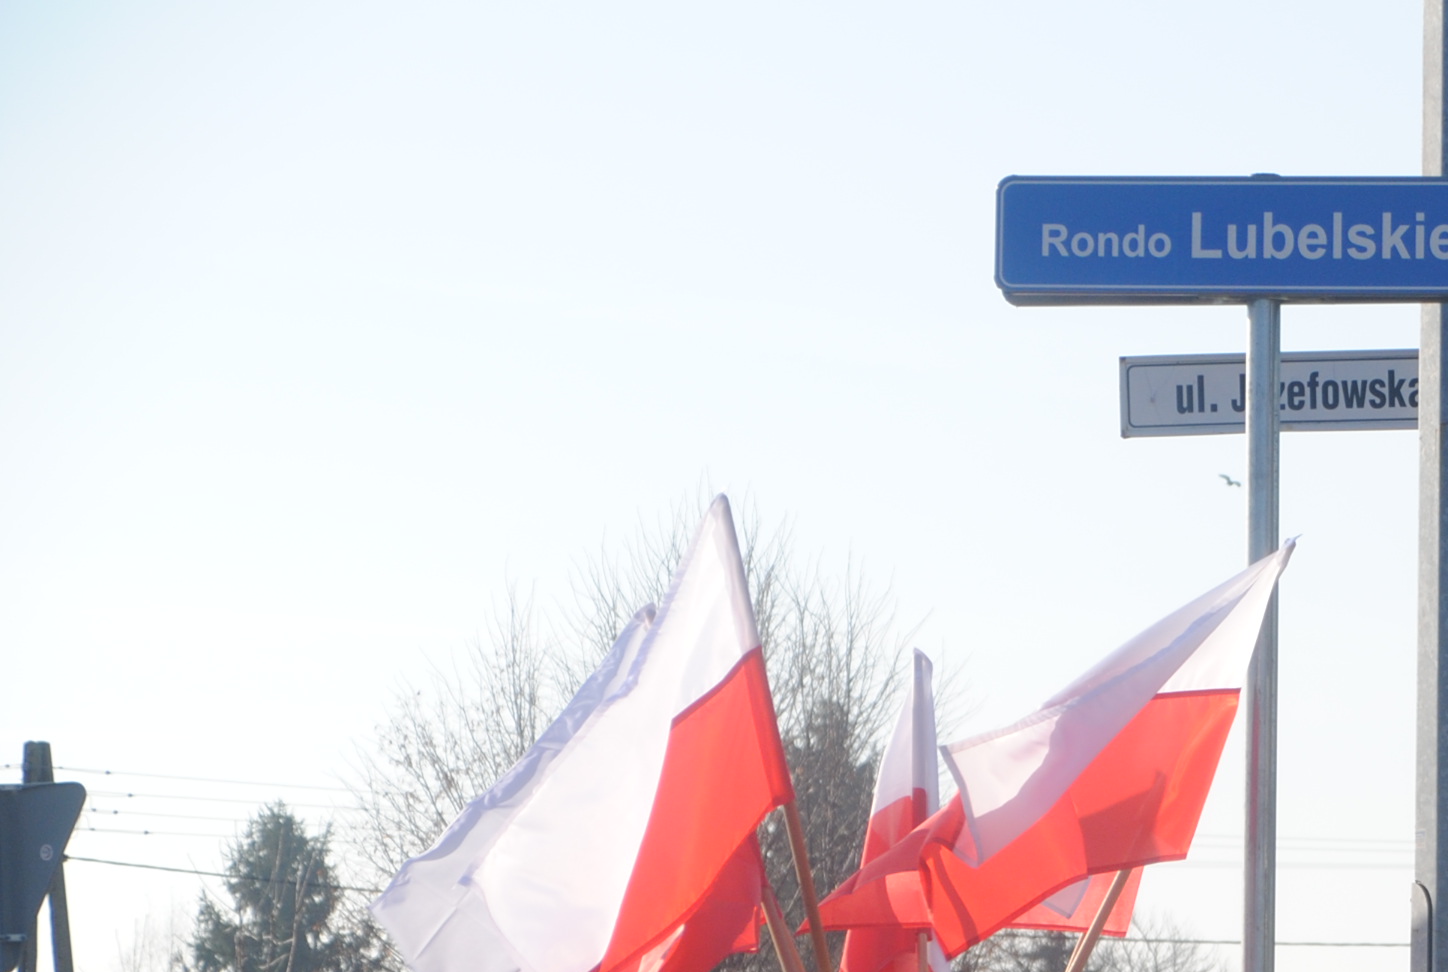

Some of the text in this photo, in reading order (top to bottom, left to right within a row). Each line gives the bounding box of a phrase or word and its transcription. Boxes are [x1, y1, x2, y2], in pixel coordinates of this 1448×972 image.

[1041, 223, 1172, 258] Rondo
[1176, 369, 1419, 414] ul. Jefowska
